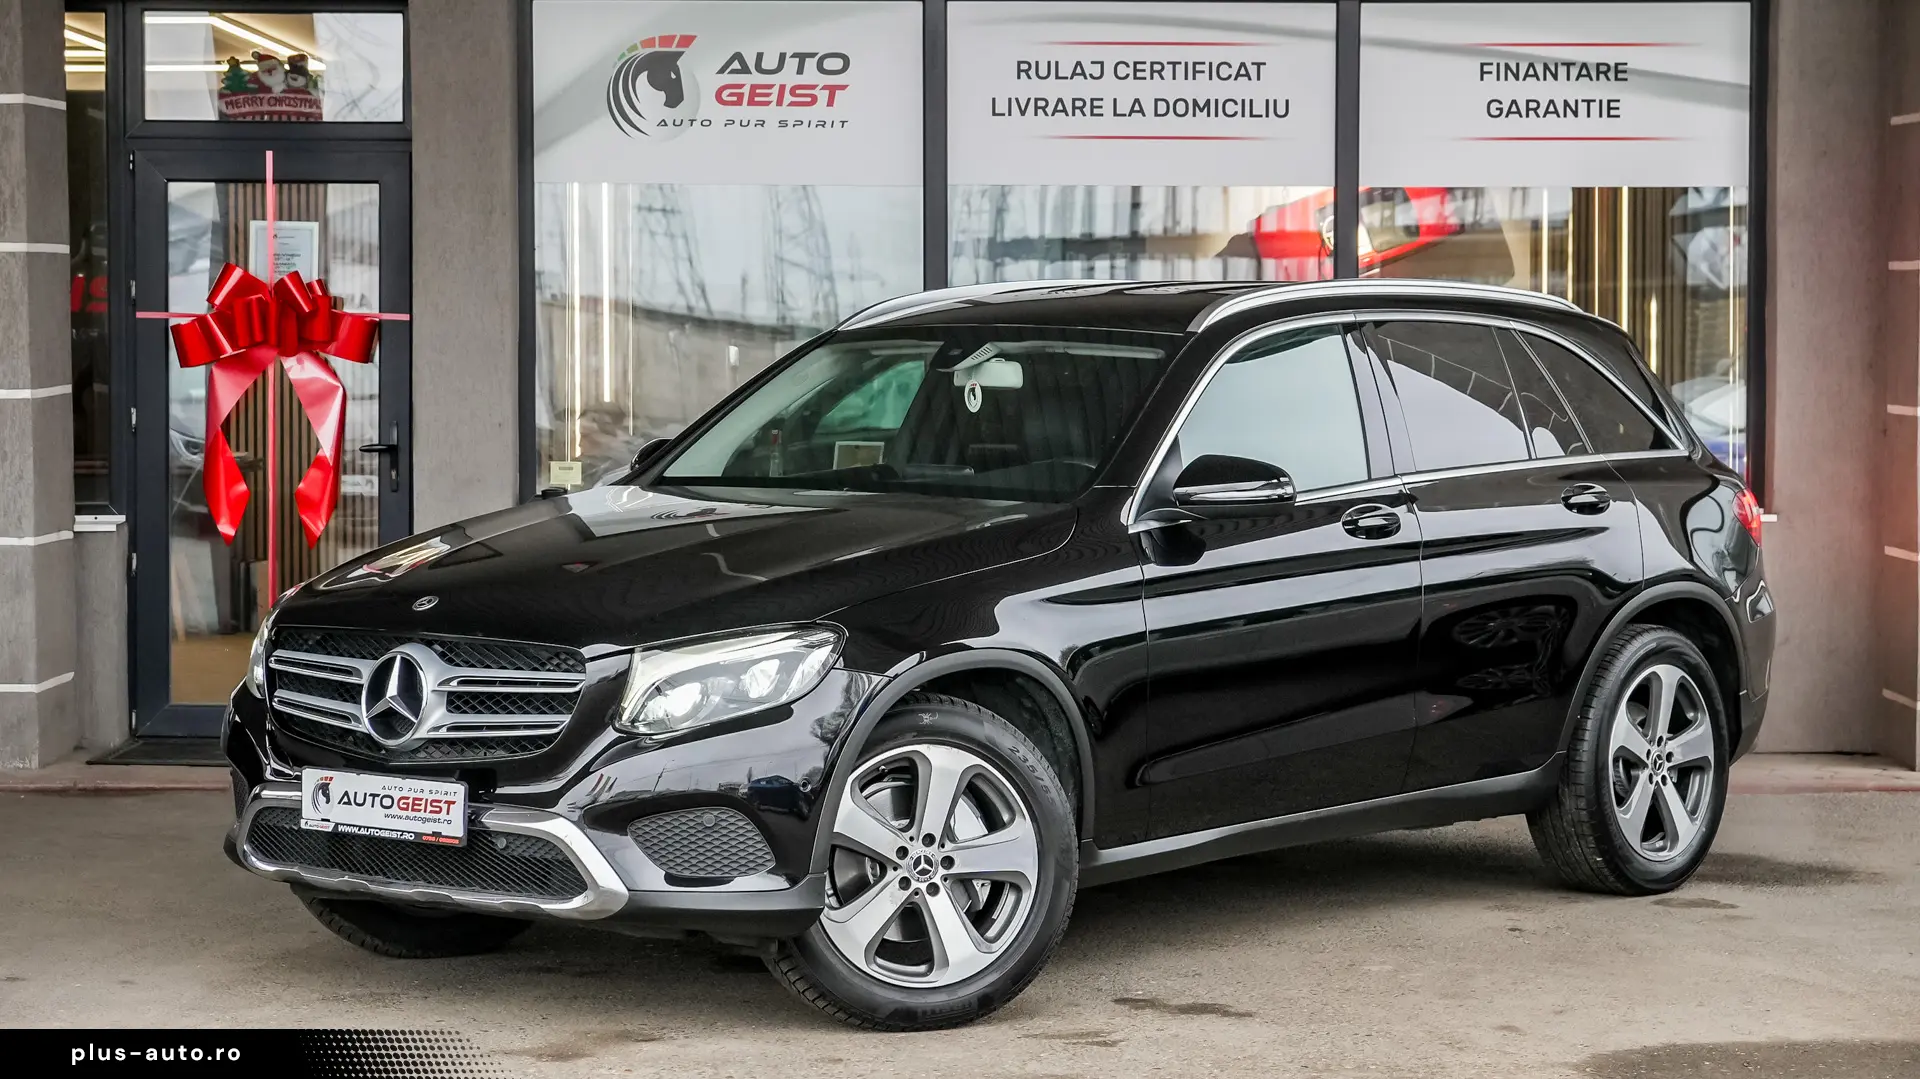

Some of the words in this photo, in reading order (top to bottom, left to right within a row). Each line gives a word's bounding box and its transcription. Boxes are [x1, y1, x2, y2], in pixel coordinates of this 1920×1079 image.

[715, 51, 851, 76] AUTO
[1015, 60, 1105, 81] RULAJ
[1112, 60, 1267, 82] CERTIFICAT
[1479, 61, 1629, 82] FINANTARE
[225, 96, 265, 110] MERRY
[267, 95, 322, 110] CHRISTMA
[714, 83, 850, 108] GEIST
[991, 97, 1105, 118] LIVRARE
[1112, 97, 1147, 118] LA
[1153, 98, 1290, 119] DOMICILIU
[1486, 98, 1621, 119] GARANTIE
[656, 118, 712, 128] AUTO
[723, 118, 766, 128] PUR
[777, 119, 849, 129] SPIRIT
[428, 789, 458, 797] SPIRIT
[384, 812, 453, 825] www.autogeist.ro
[337, 824, 416, 841] WWW.AUTOGEIST.RO
